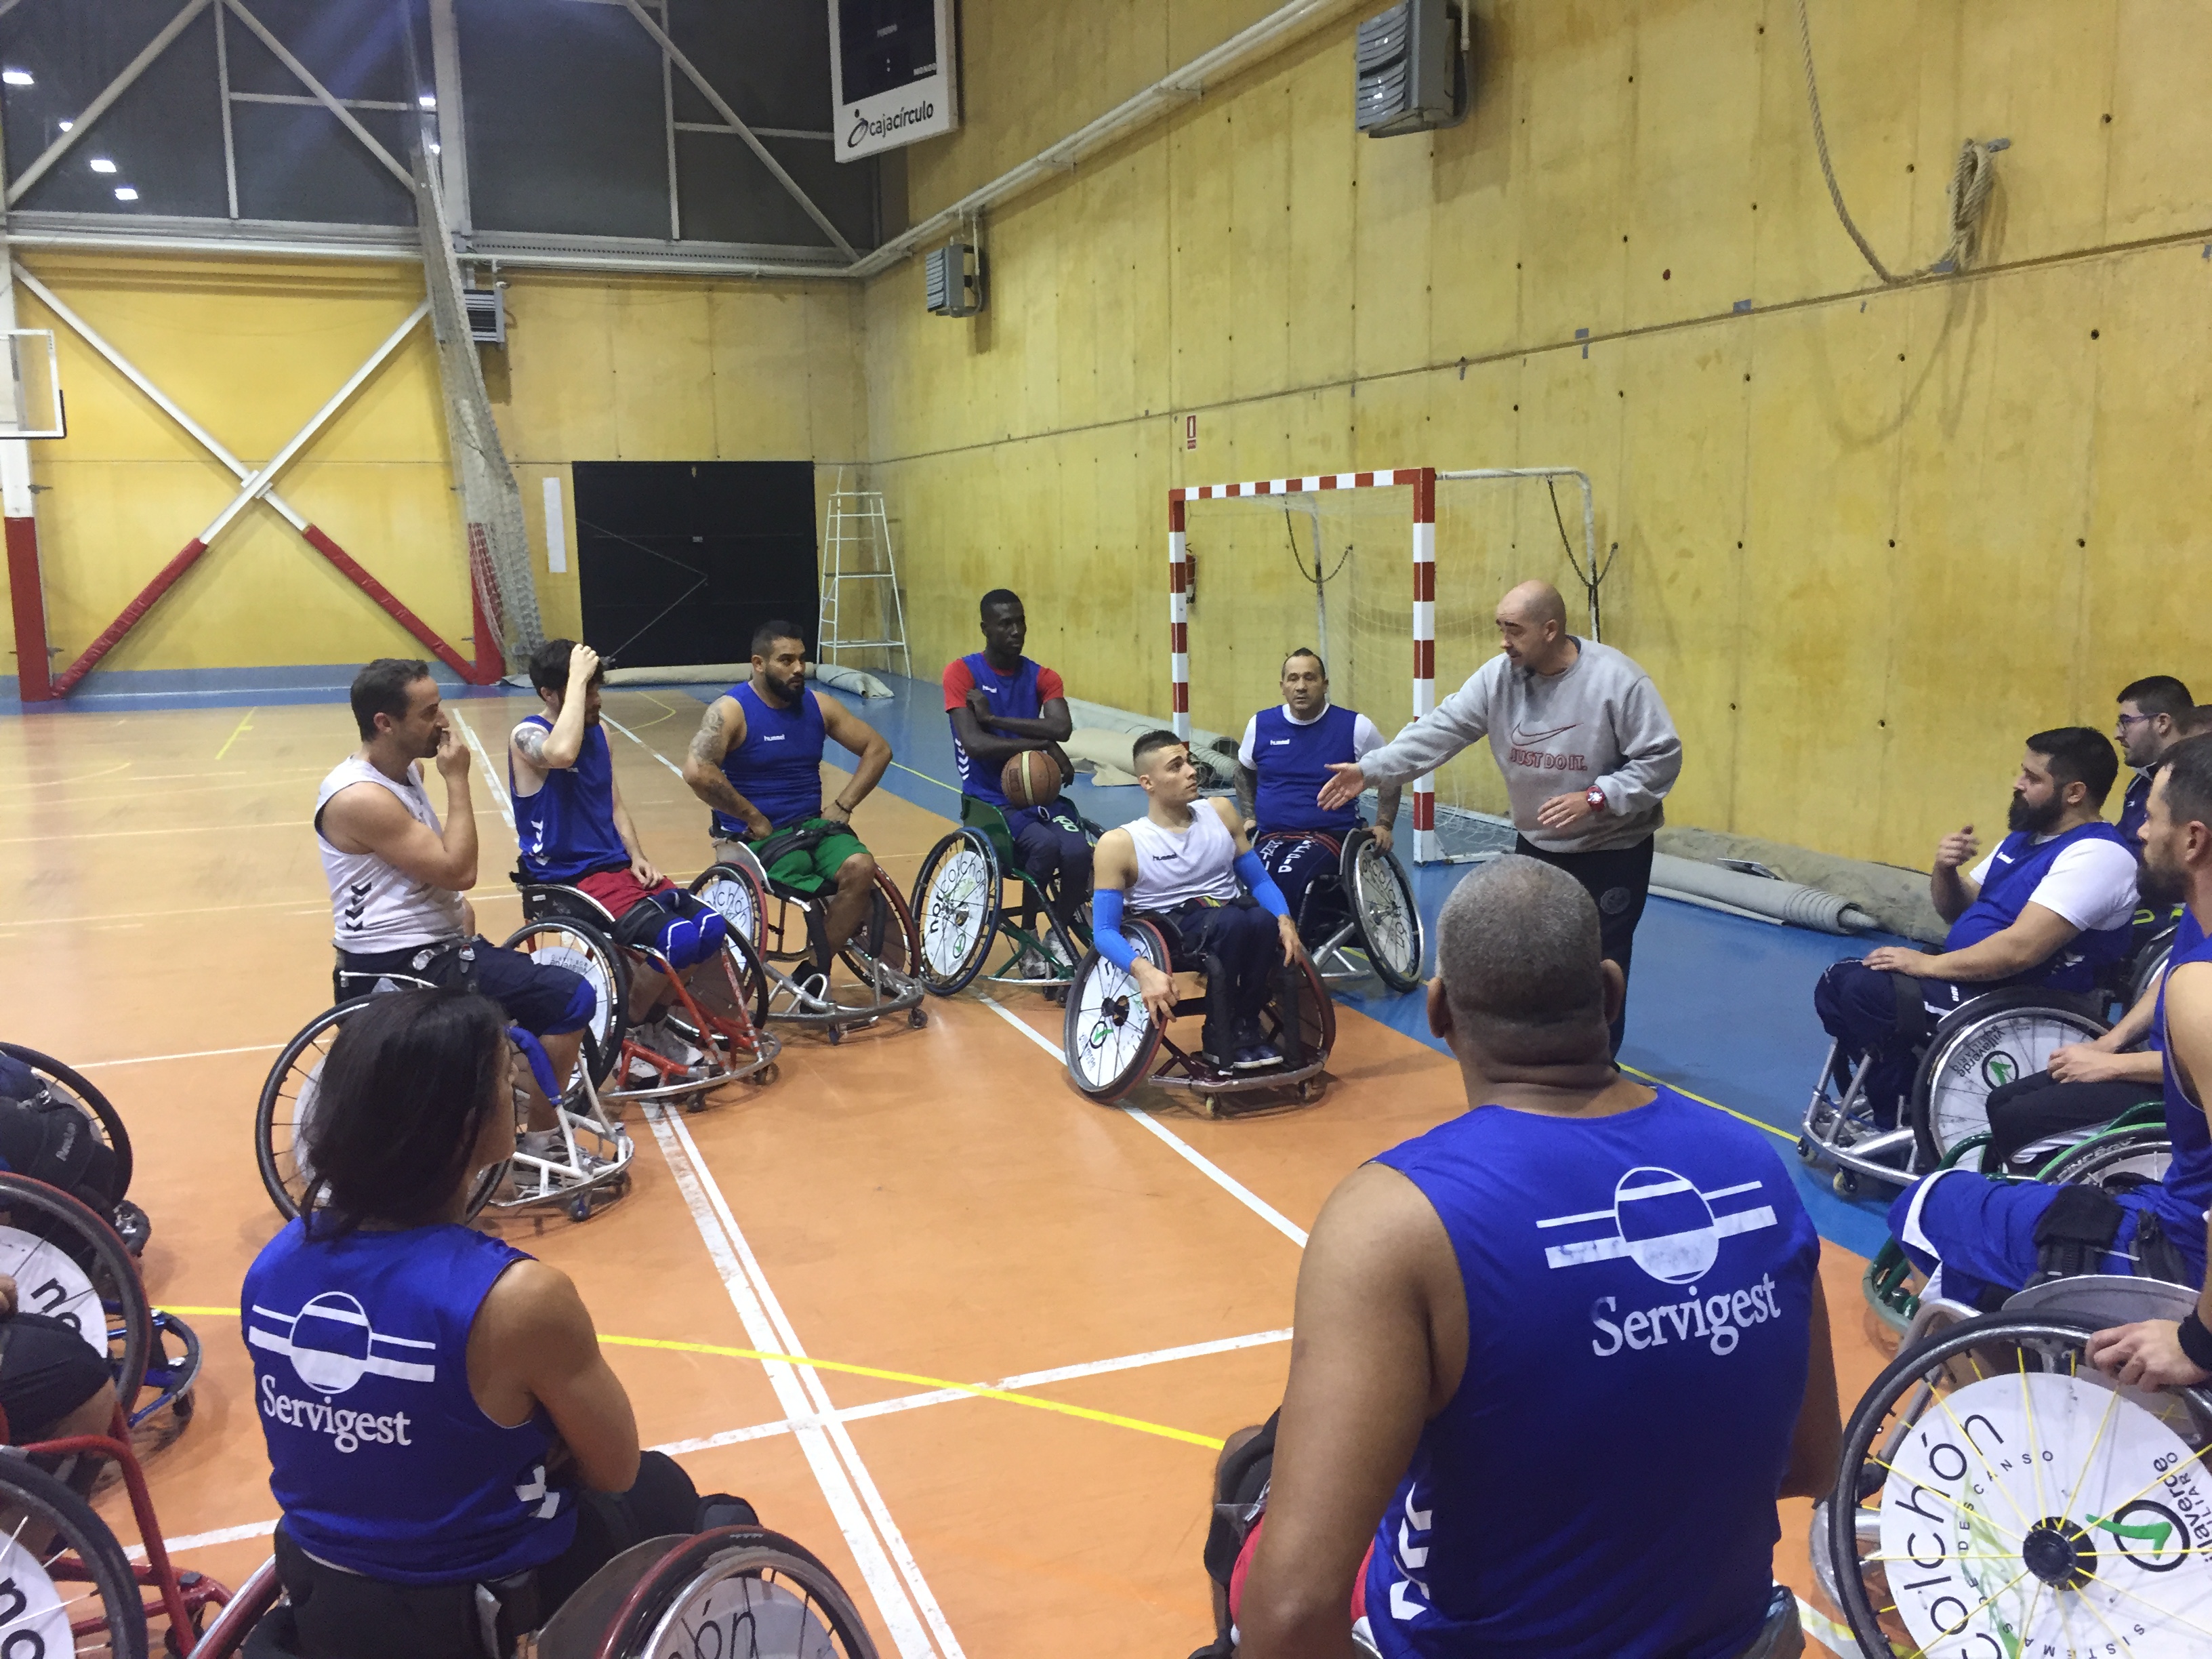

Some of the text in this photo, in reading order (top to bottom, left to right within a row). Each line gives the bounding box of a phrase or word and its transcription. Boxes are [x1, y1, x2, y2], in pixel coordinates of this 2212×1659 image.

[869, 100, 934, 138] cajacírculo
[1509, 747, 1544, 768] JUST
[1544, 753, 1567, 771] DO
[1591, 1273, 1781, 1357] Servigest
[262, 1374, 411, 1454] Servigest
